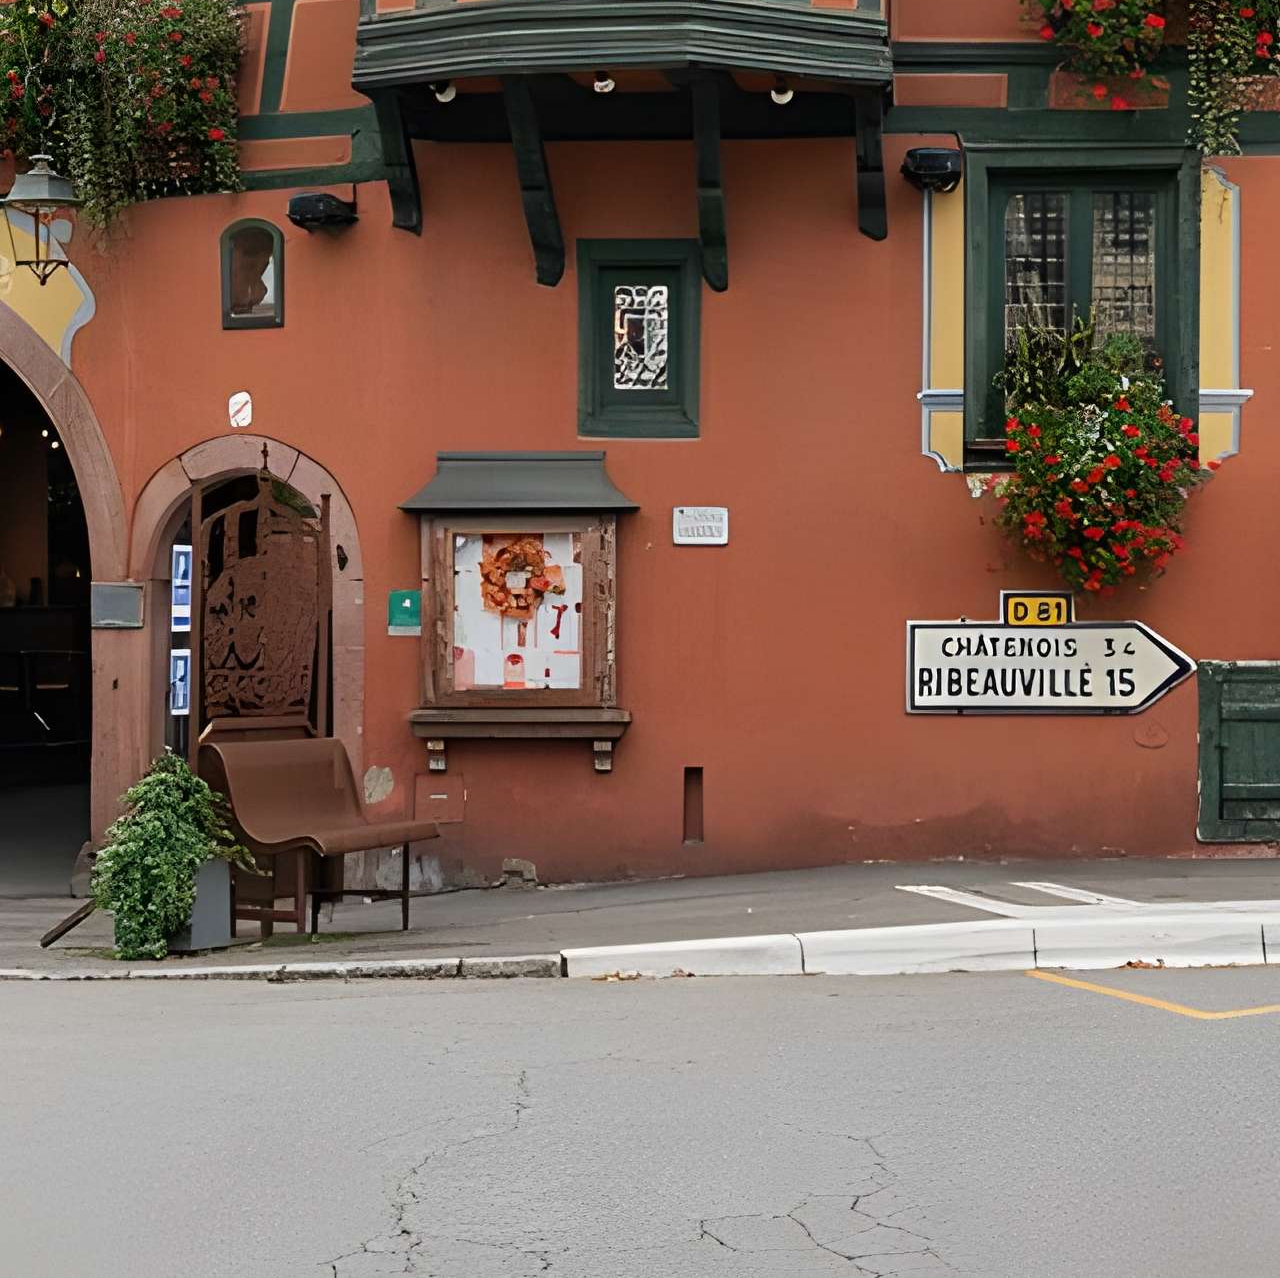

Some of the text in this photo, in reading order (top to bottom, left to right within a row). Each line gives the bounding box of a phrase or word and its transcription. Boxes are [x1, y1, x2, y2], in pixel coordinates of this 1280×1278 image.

[1013, 601, 1063, 622] D 81
[1105, 667, 1136, 698] 15
